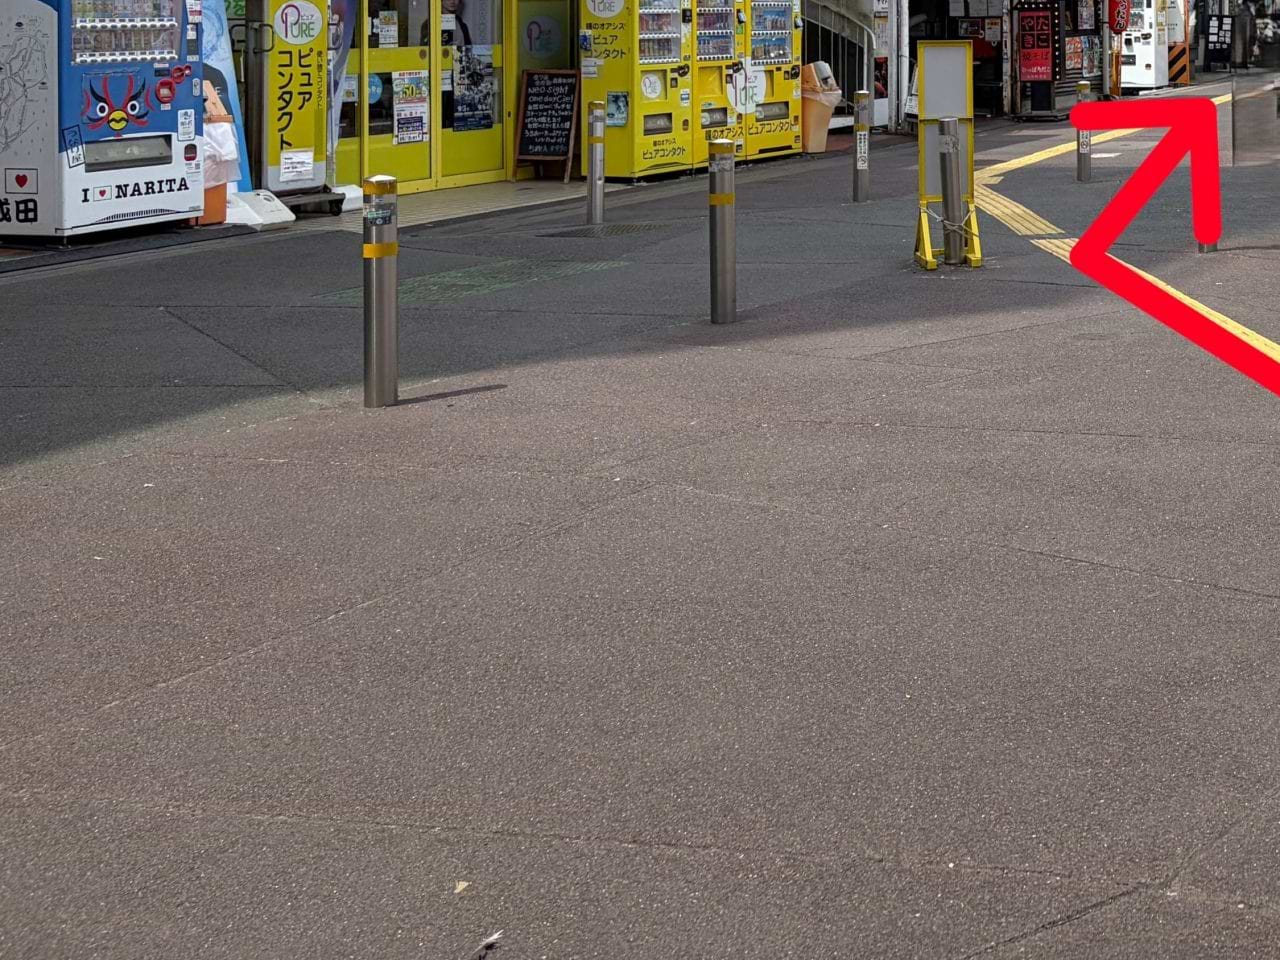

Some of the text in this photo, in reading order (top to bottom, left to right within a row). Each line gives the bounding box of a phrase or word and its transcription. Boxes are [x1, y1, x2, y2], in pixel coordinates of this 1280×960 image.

[592, 34, 618, 45] ピュア
[298, 47, 314, 110] ピュア
[277, 50, 293, 150] コンタクト
[747, 120, 795, 136] ピュアコンタクト
[642, 146, 687, 160] ピュアコンタクト
[115, 177, 190, 199] NARITA
